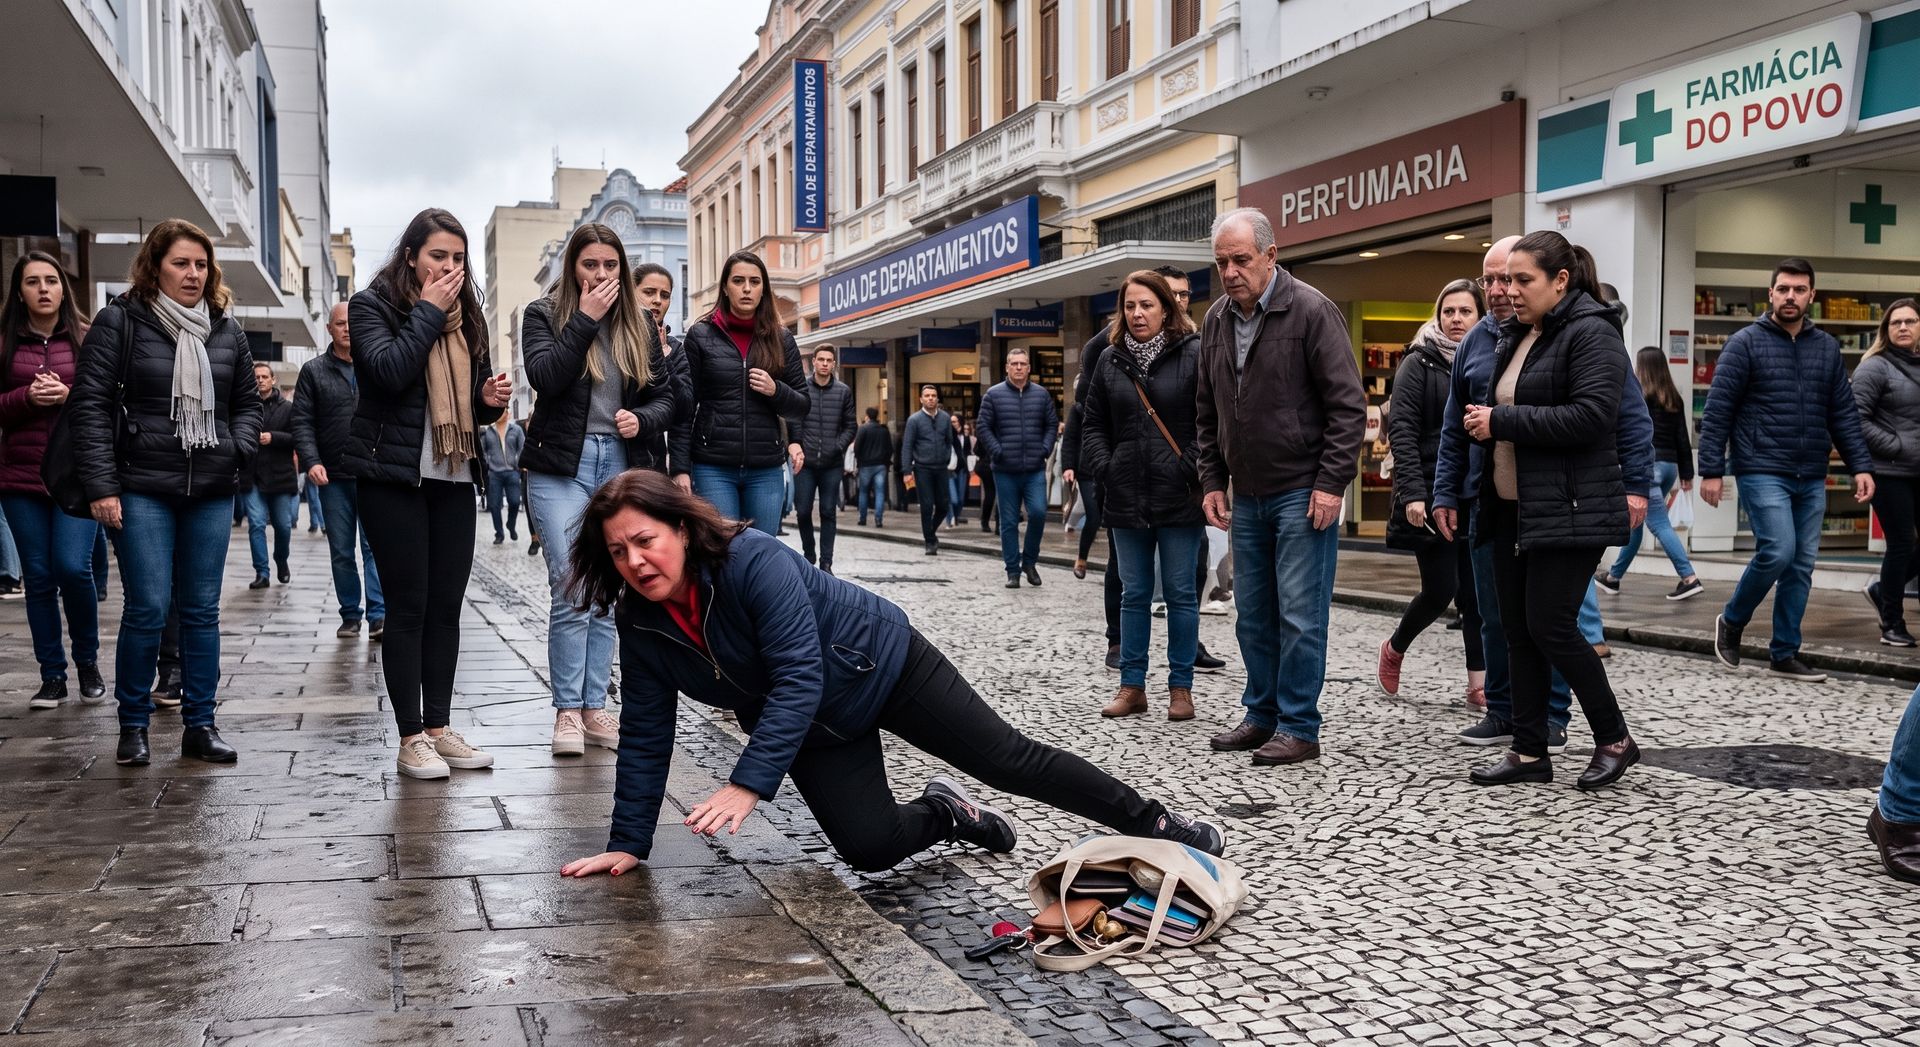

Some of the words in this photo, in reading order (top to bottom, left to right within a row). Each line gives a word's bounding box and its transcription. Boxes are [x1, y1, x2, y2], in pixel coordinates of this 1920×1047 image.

[1686, 41, 1842, 109] FARMÁCIA
[805, 67, 816, 171] DEPARTAMENTOS
[1686, 111, 1731, 150] DO
[1743, 82, 1842, 137] POVO
[805, 174, 816, 193] DE
[805, 193, 816, 224] LOJA
[1281, 144, 1468, 227] PERFUMARIA
[828, 277, 858, 313] LOJA
[861, 270, 877, 304] DE
[880, 216, 1018, 297] DEPARTAMENTOS
